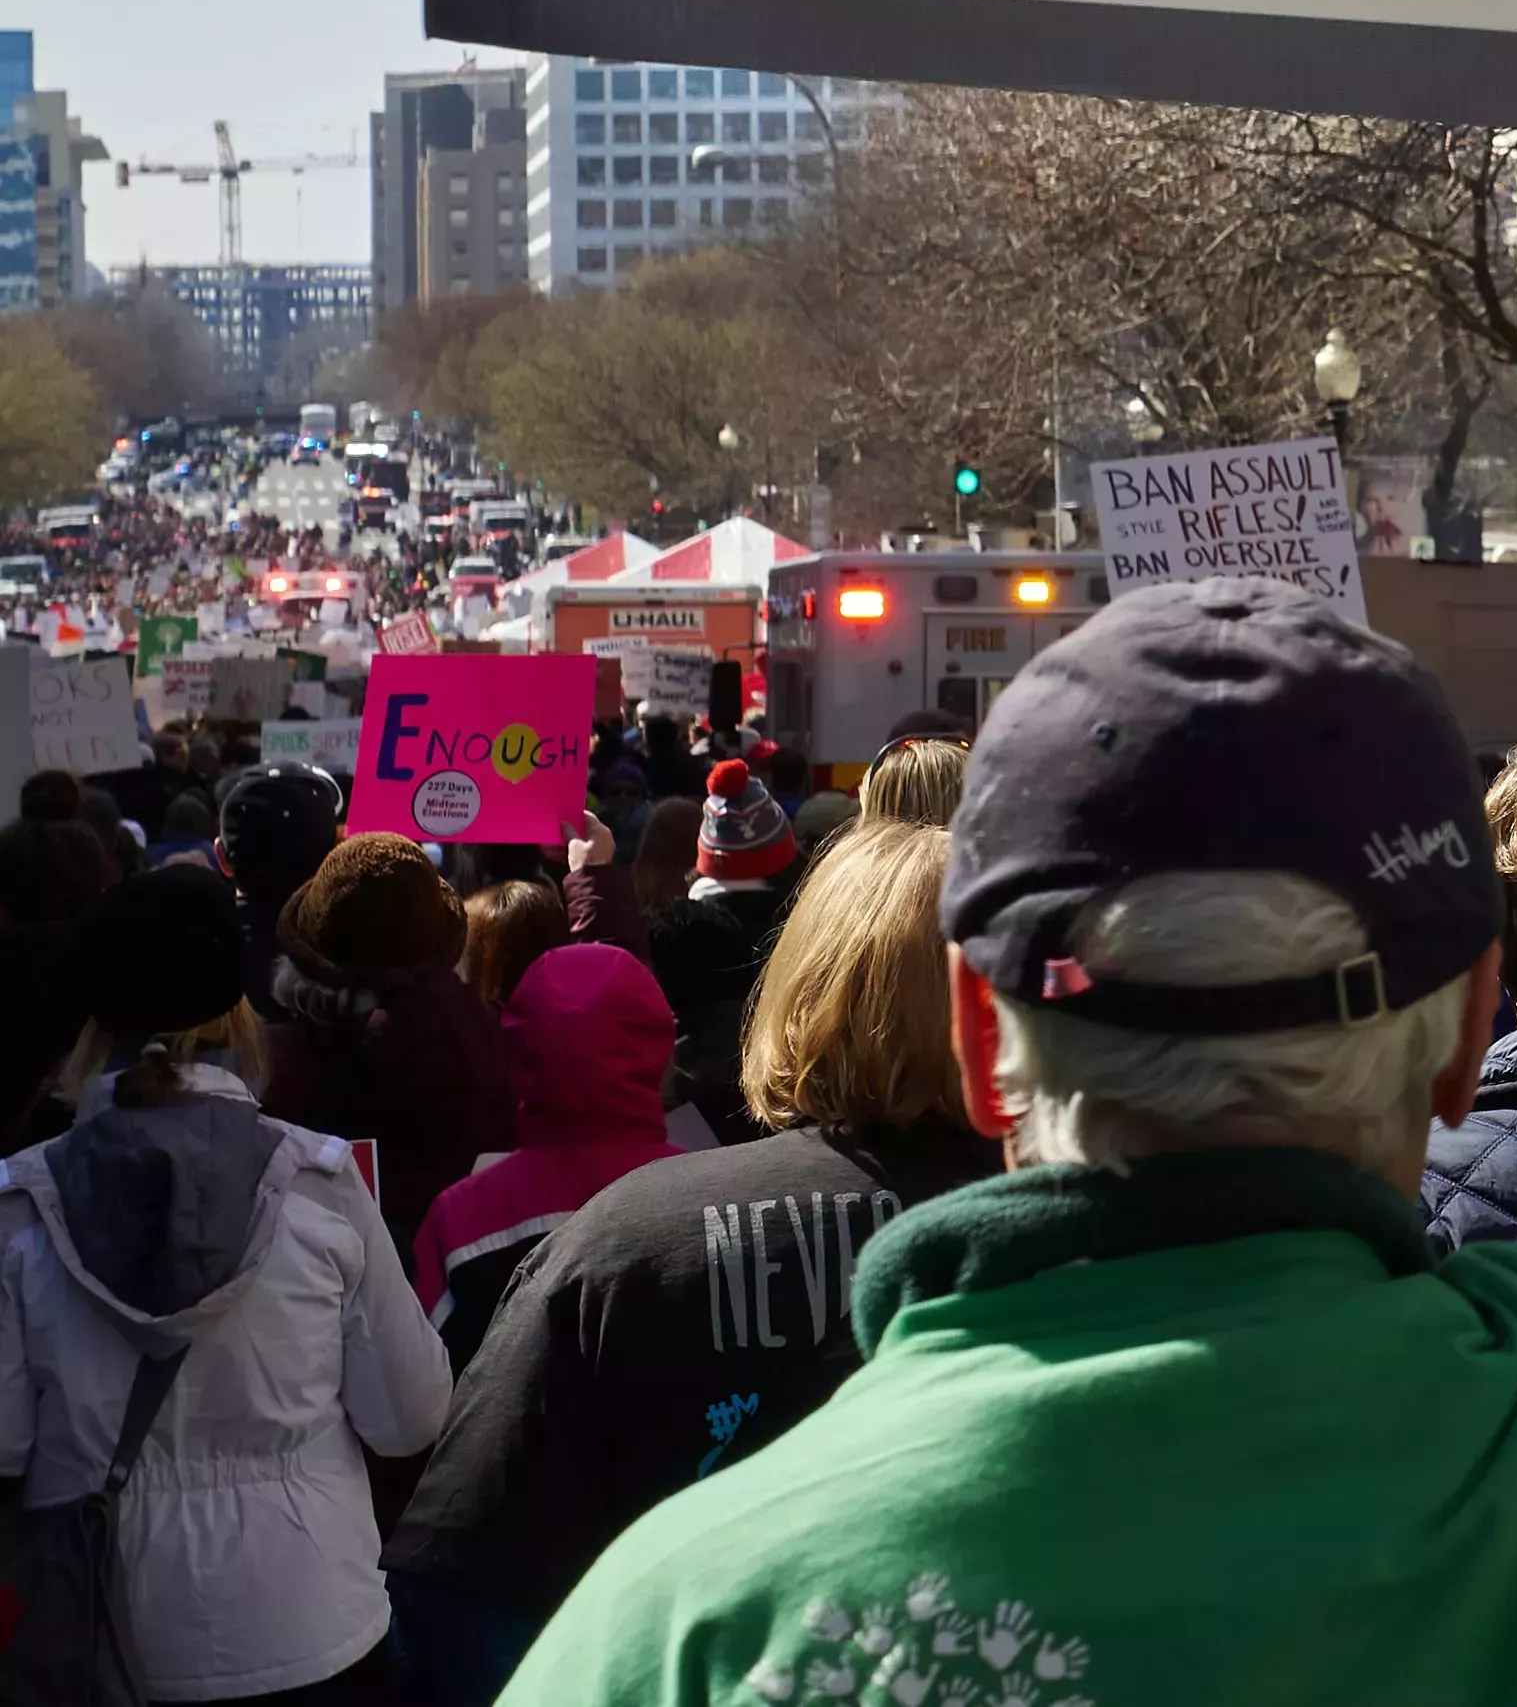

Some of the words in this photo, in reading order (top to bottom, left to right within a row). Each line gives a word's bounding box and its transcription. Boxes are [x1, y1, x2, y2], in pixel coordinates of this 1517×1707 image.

[1102, 463, 1196, 511] BAN
[1210, 446, 1338, 500] ASSAULT
[1116, 519, 1166, 539] STYLE
[1178, 494, 1308, 543] RIFLES!
[1112, 550, 1170, 580] BAN
[1184, 537, 1320, 569] OVERSIZE
[612, 611, 699, 628] U-HAUL
[32, 663, 112, 706] OKS
[427, 781, 446, 791] 227
[448, 781, 474, 794] Days
[703, 1190, 903, 1353] NEVE
